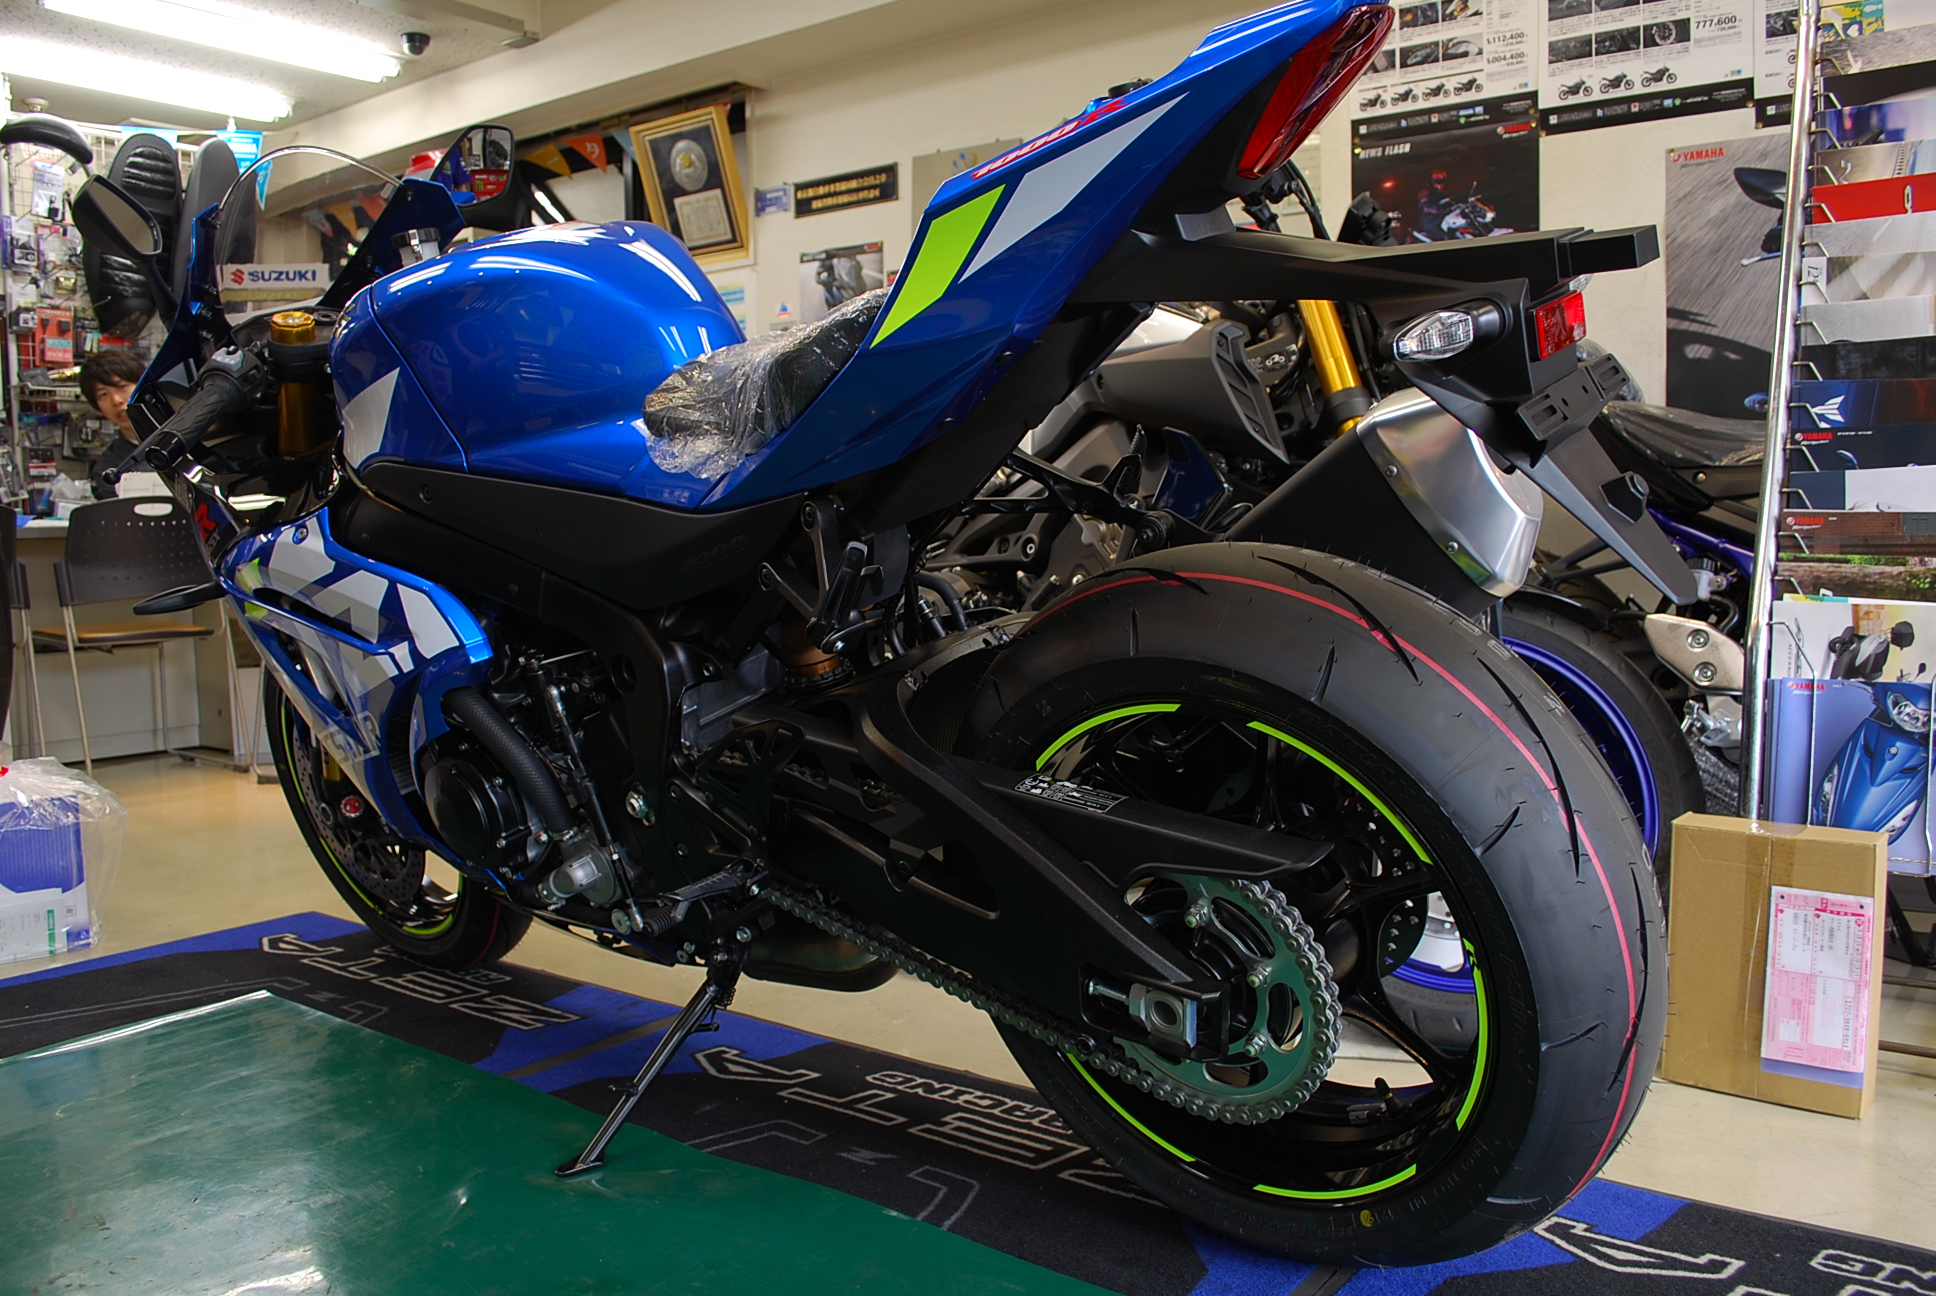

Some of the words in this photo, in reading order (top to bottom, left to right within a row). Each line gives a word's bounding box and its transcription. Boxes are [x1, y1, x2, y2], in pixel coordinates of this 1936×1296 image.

[1695, 15, 1737, 30] 777,600
[1384, 142, 1411, 156] FLASH
[1683, 147, 1725, 162] YAMAHA
[248, 269, 317, 282] SUZUKI
[1803, 432, 1833, 440] YAMAHA
